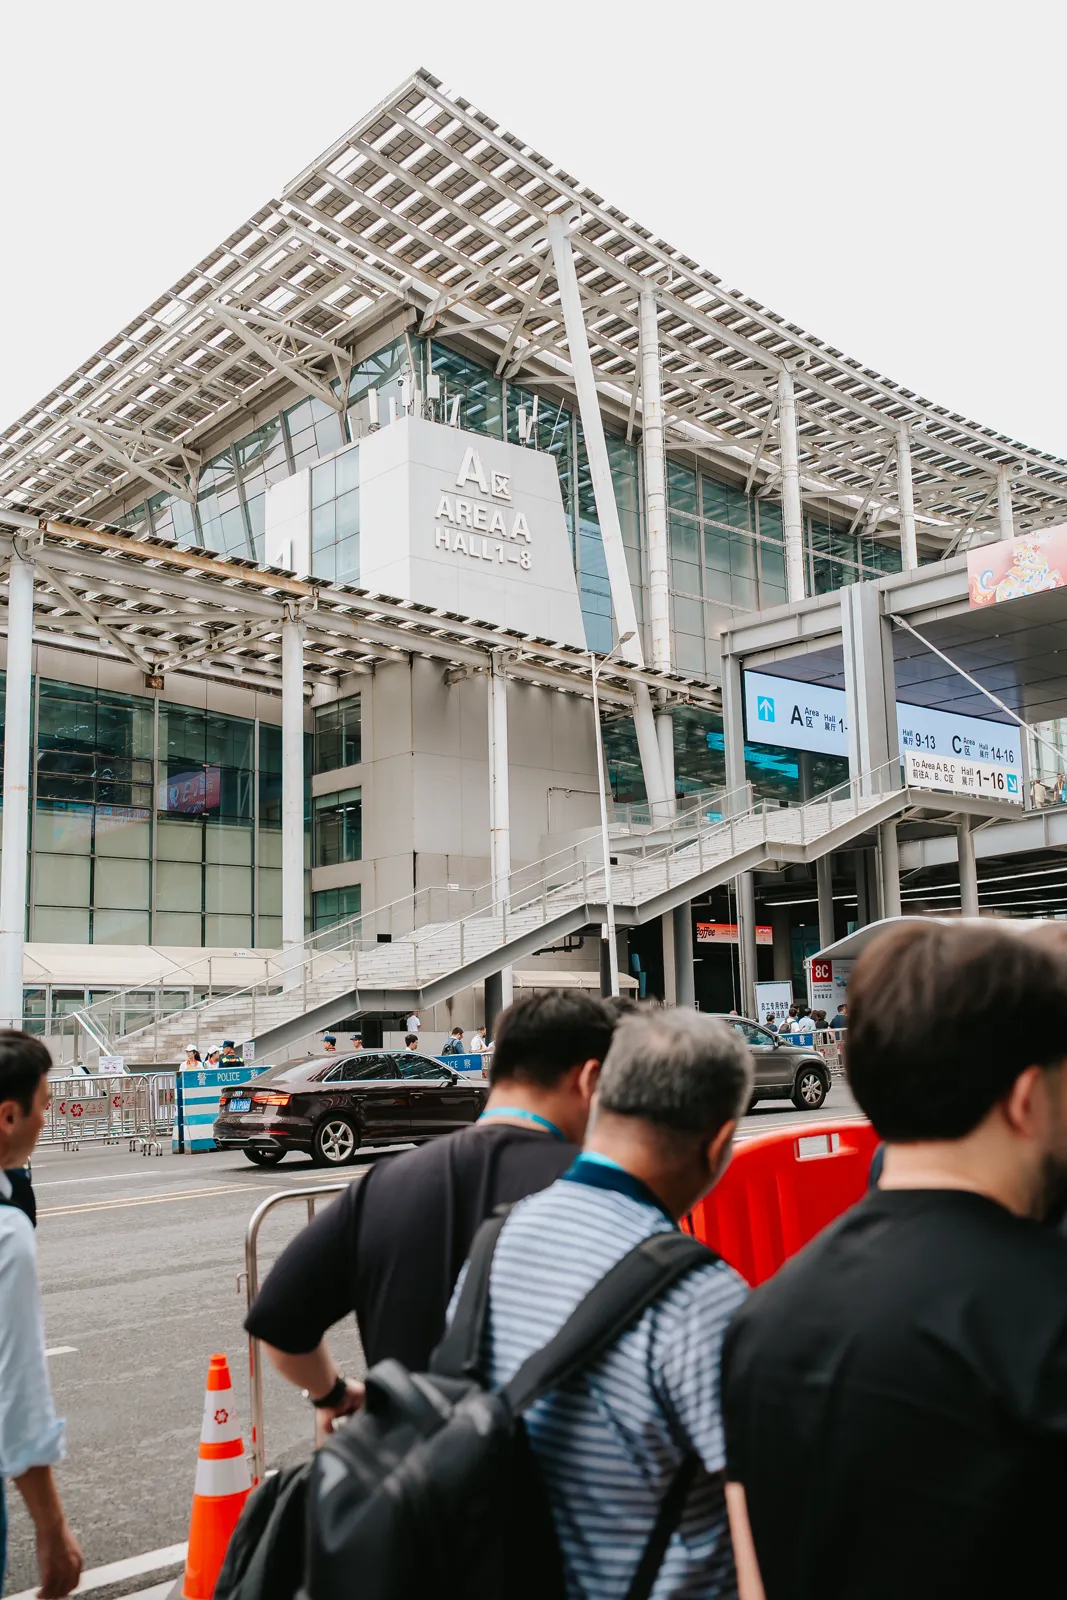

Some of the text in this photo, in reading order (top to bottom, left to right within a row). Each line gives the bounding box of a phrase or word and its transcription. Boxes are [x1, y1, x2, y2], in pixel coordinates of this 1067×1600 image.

[455, 446, 512, 501] A 区
[435, 495, 532, 544] AREA A
[790, 704, 804, 727] A
[804, 707, 819, 717] Area
[805, 716, 813, 728] 区
[824, 713, 836, 723] Hall
[824, 721, 836, 732] 展厅
[902, 728, 913, 738] Hall
[902, 735, 913, 746] 展厅
[915, 732, 936, 750] 9-13
[952, 735, 962, 755] C
[963, 736, 976, 746] Area
[964, 745, 971, 756] 区
[979, 742, 989, 751] Hall
[979, 749, 989, 759] 展厅
[990, 746, 1014, 764] 14-16
[912, 758, 920, 768] To
[921, 760, 935, 771] Area
[961, 766, 974, 776] Hall
[961, 775, 974, 787] 展厅
[976, 769, 1005, 791] 1-16
[815, 964, 829, 978] 8C
[217, 1071, 240, 1082] POLICE
